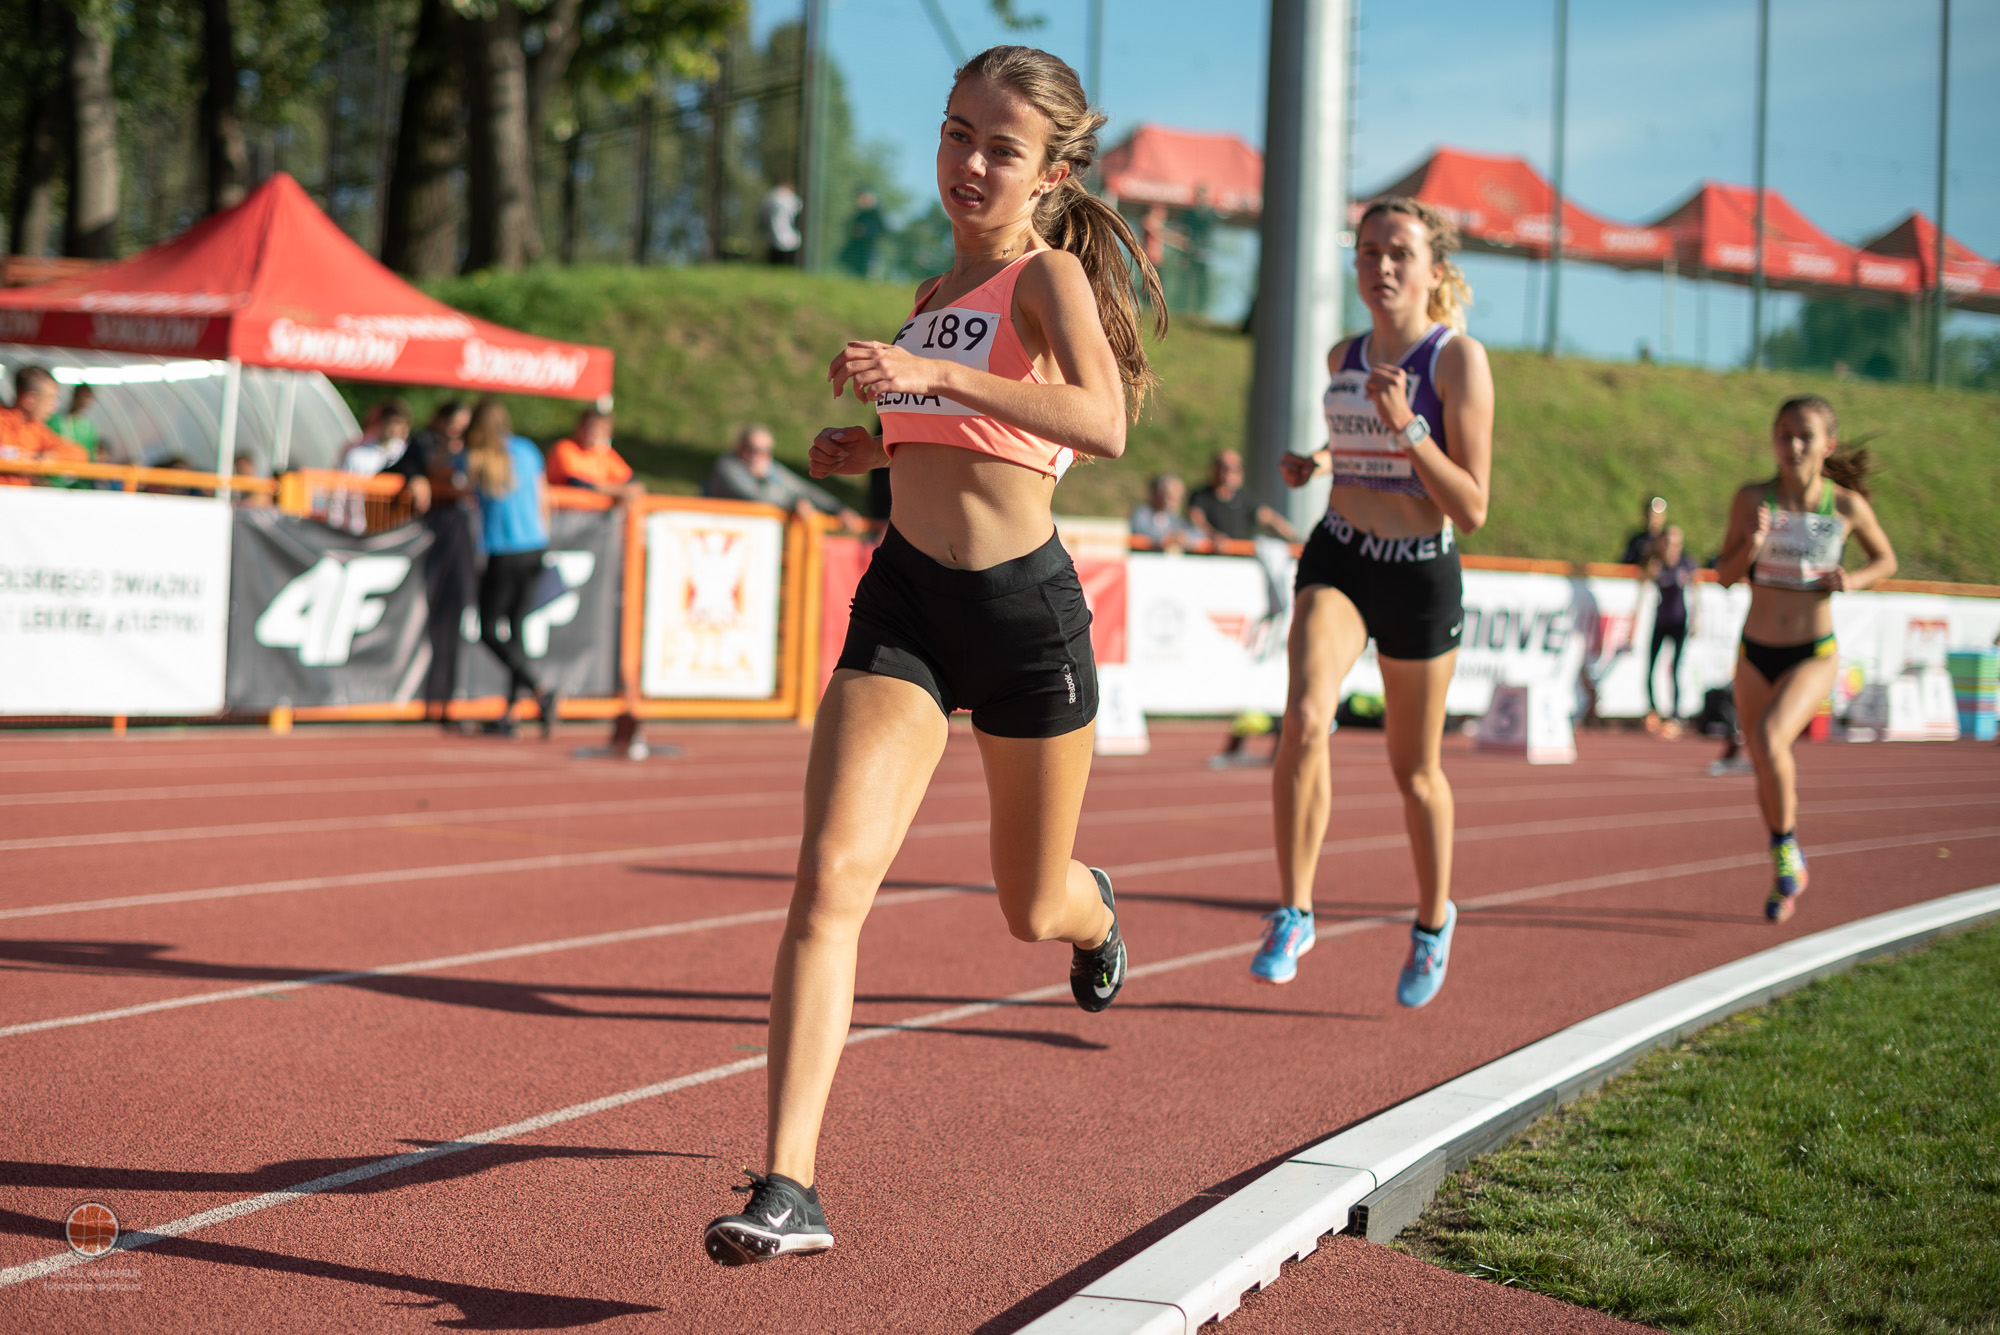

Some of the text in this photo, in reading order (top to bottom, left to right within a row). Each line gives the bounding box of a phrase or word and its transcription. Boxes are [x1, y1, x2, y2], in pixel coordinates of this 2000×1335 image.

[922, 314, 988, 351] 189
[1359, 534, 1438, 563] NIKE
[255, 555, 411, 667] 4F
[1064, 672, 1077, 704] Reebok
